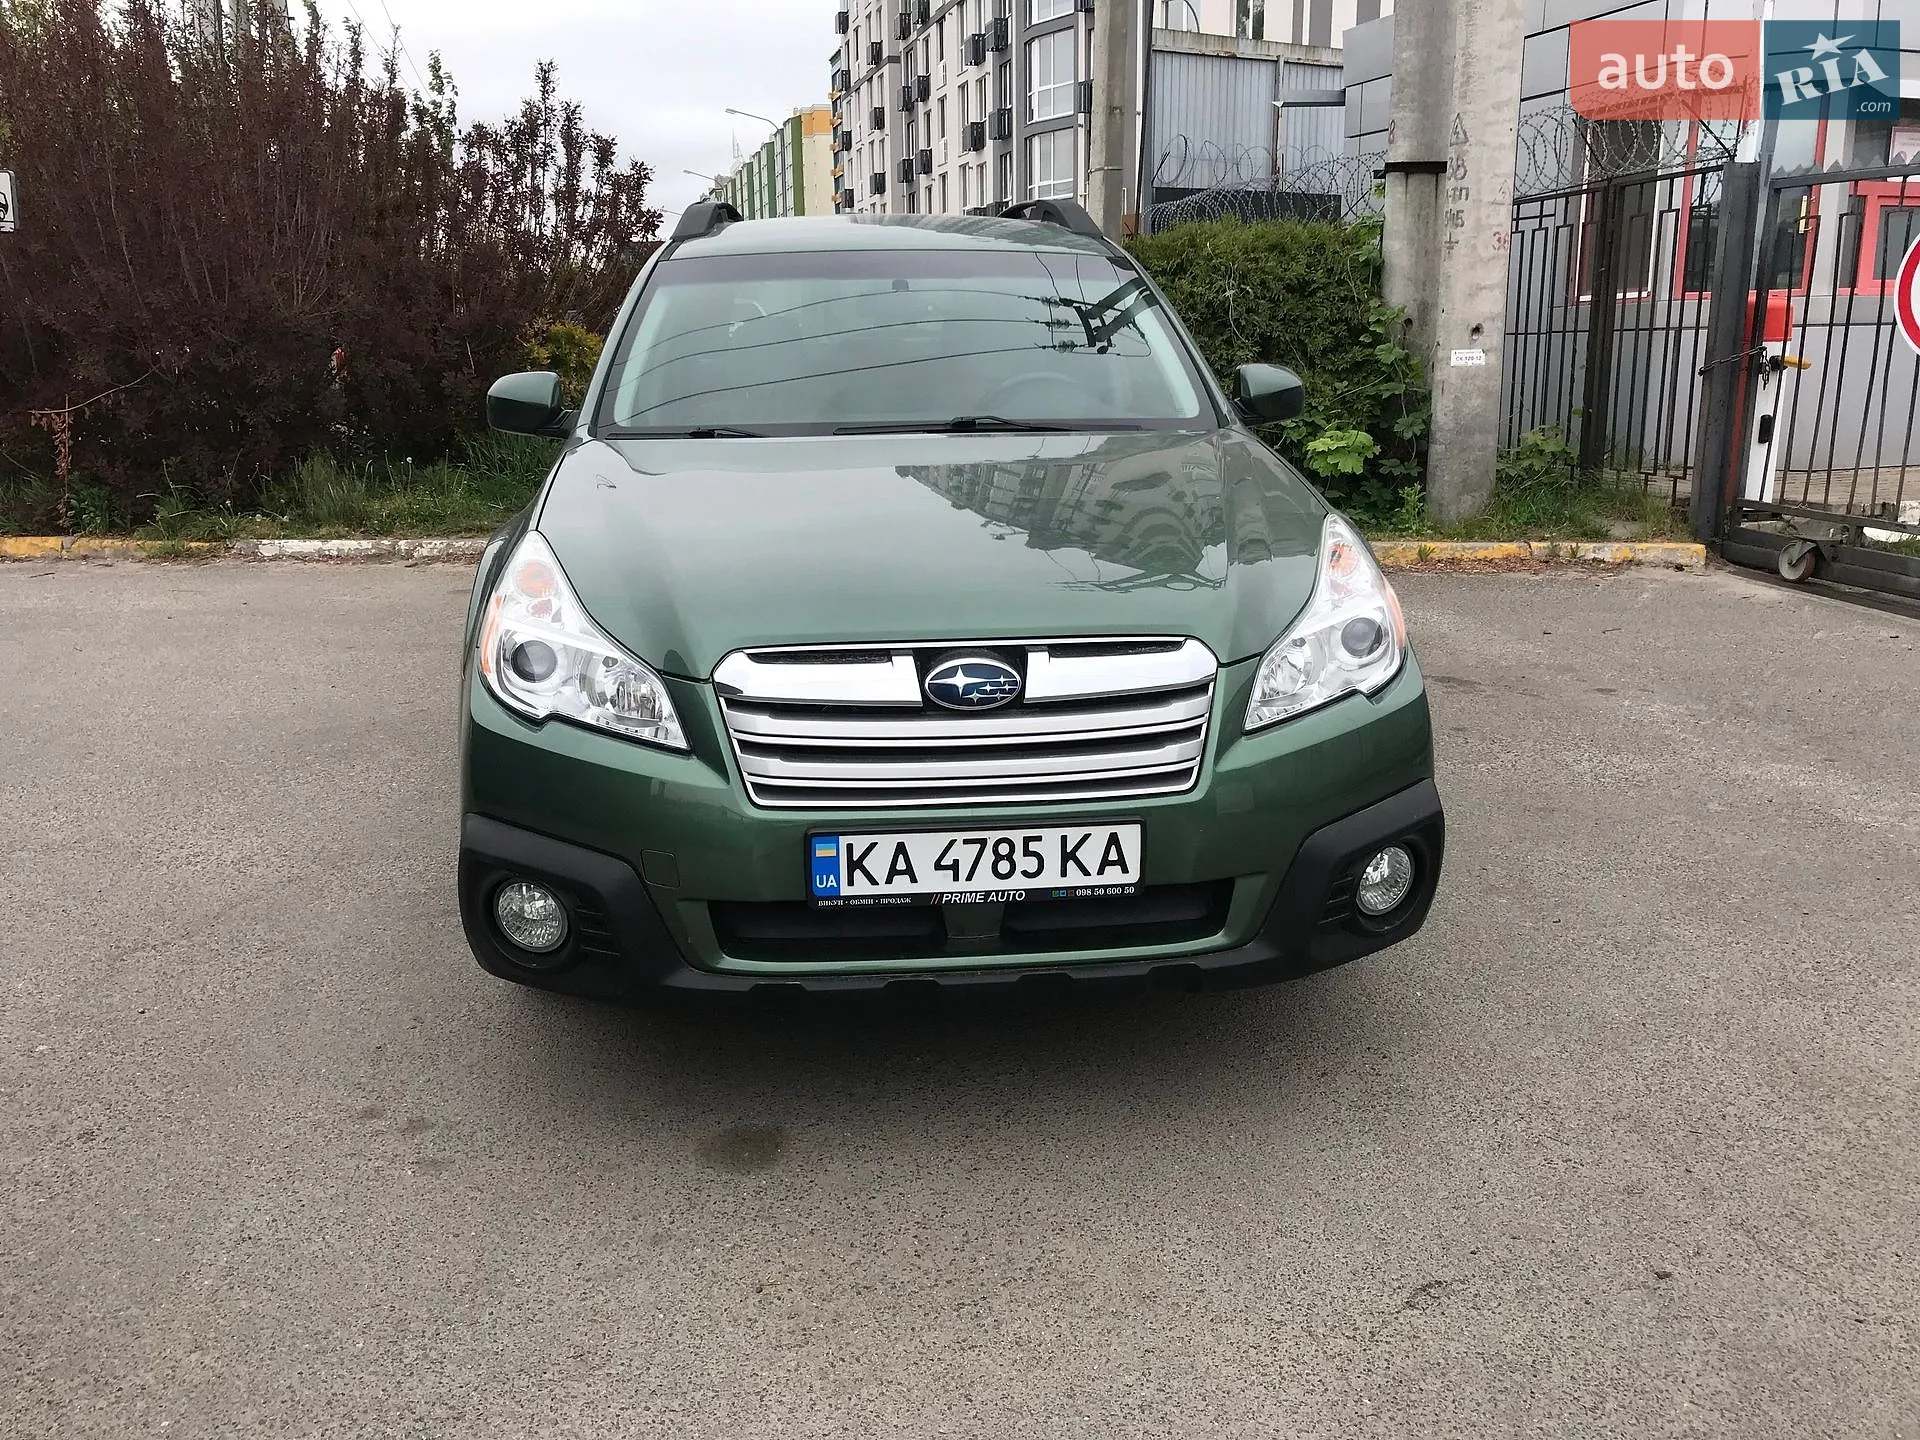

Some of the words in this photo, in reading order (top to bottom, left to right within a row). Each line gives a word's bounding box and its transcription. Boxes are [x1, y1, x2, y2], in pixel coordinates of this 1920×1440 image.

[846, 841, 918, 886] KA
[934, 835, 1045, 882] 4785
[1060, 832, 1129, 878] KA
[816, 874, 837, 889] UA
[941, 891, 986, 904] PRIME
[987, 890, 1026, 902] AUTO
[1076, 888, 1092, 897] 098
[1093, 887, 1105, 896] 50
[1106, 887, 1122, 895] 600
[1124, 886, 1135, 894] 50
[880, 897, 912, 905] ПРОДАЖ
